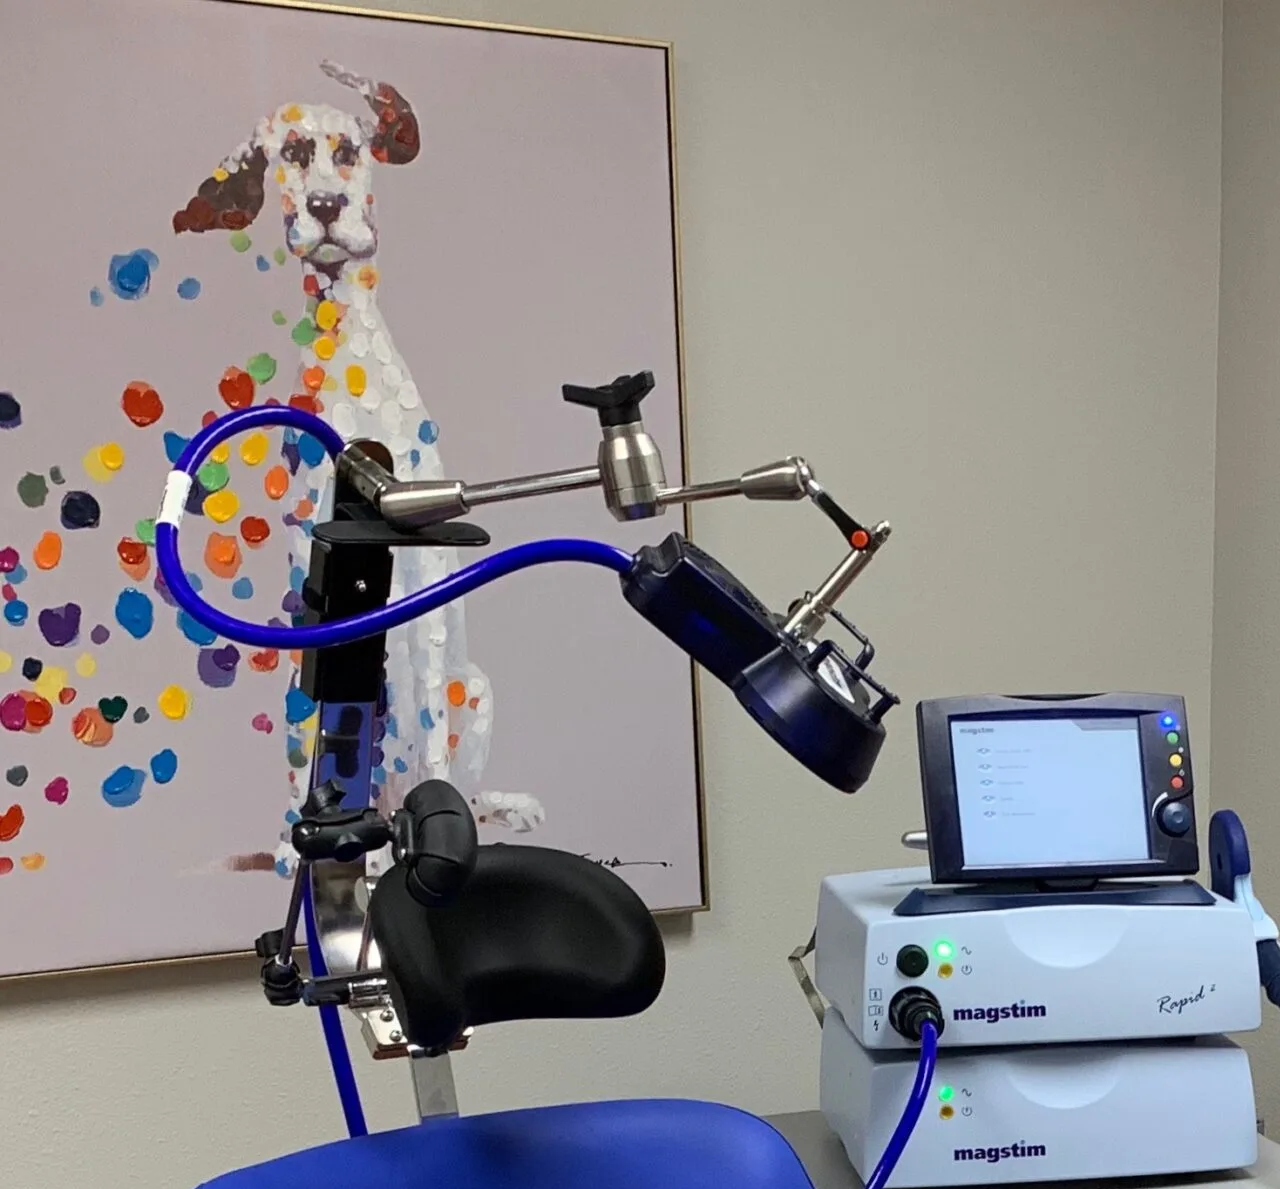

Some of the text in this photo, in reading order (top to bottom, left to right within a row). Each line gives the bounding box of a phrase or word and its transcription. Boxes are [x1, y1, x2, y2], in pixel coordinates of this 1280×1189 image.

[953, 1000, 1047, 1023] magstim
[1157, 985, 1205, 1015] Rapid
[953, 1140, 1047, 1163] magstim
